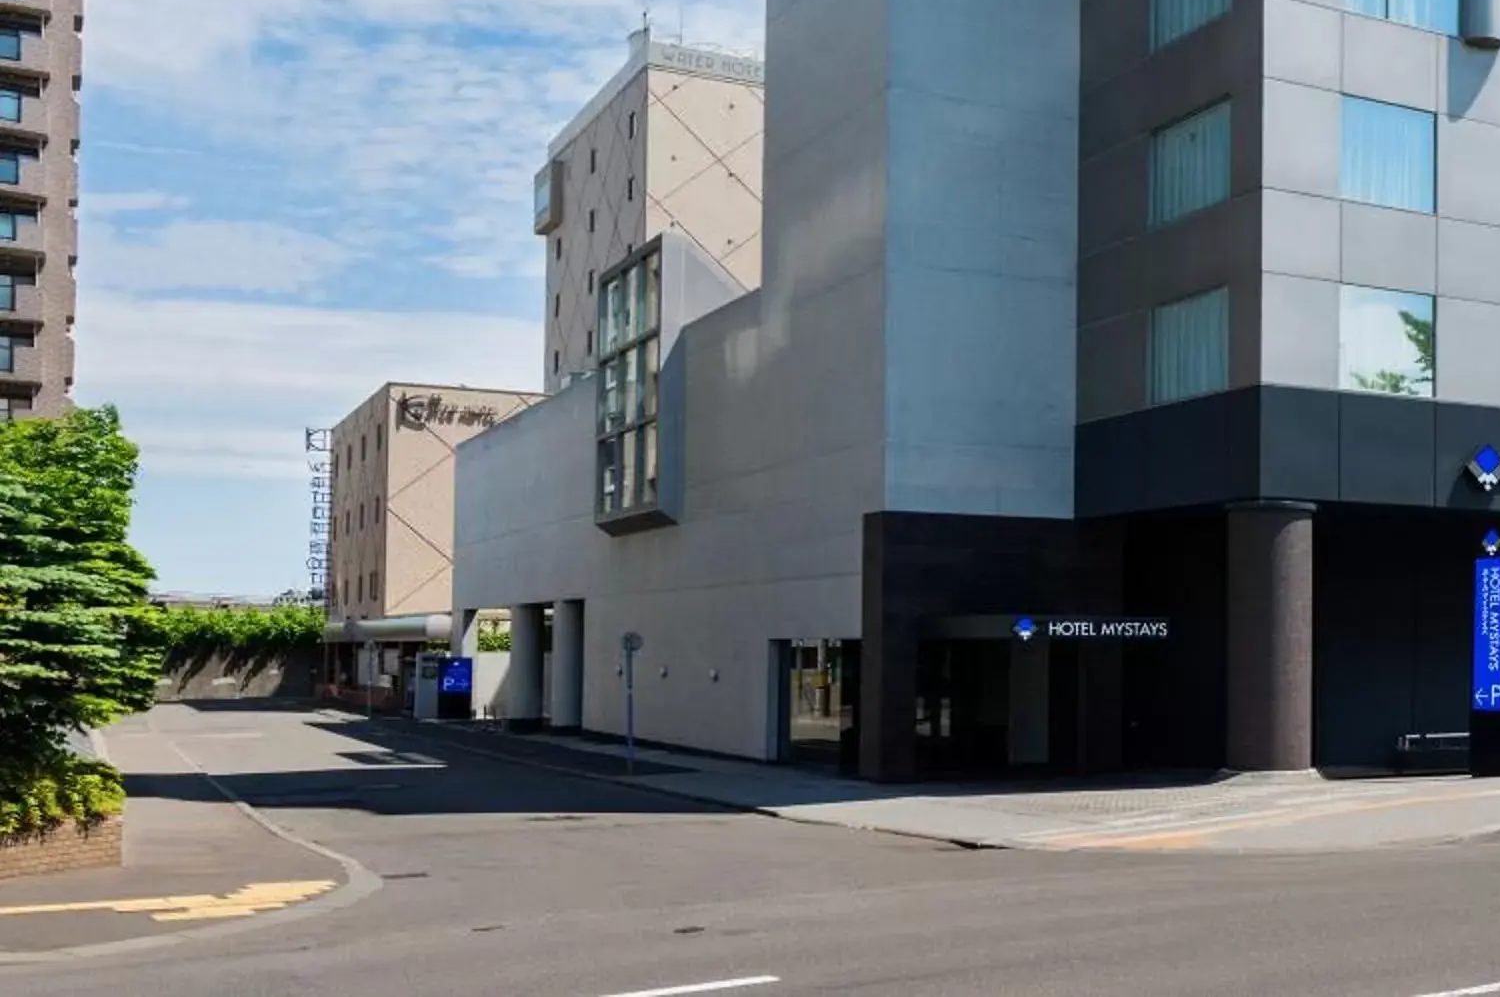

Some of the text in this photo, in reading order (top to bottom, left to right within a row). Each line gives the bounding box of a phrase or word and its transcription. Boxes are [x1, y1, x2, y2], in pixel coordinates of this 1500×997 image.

[1049, 622, 1168, 638] HOTEL MYSTAYS
[1488, 567, 1500, 672] HOTEL MYSTAYS
